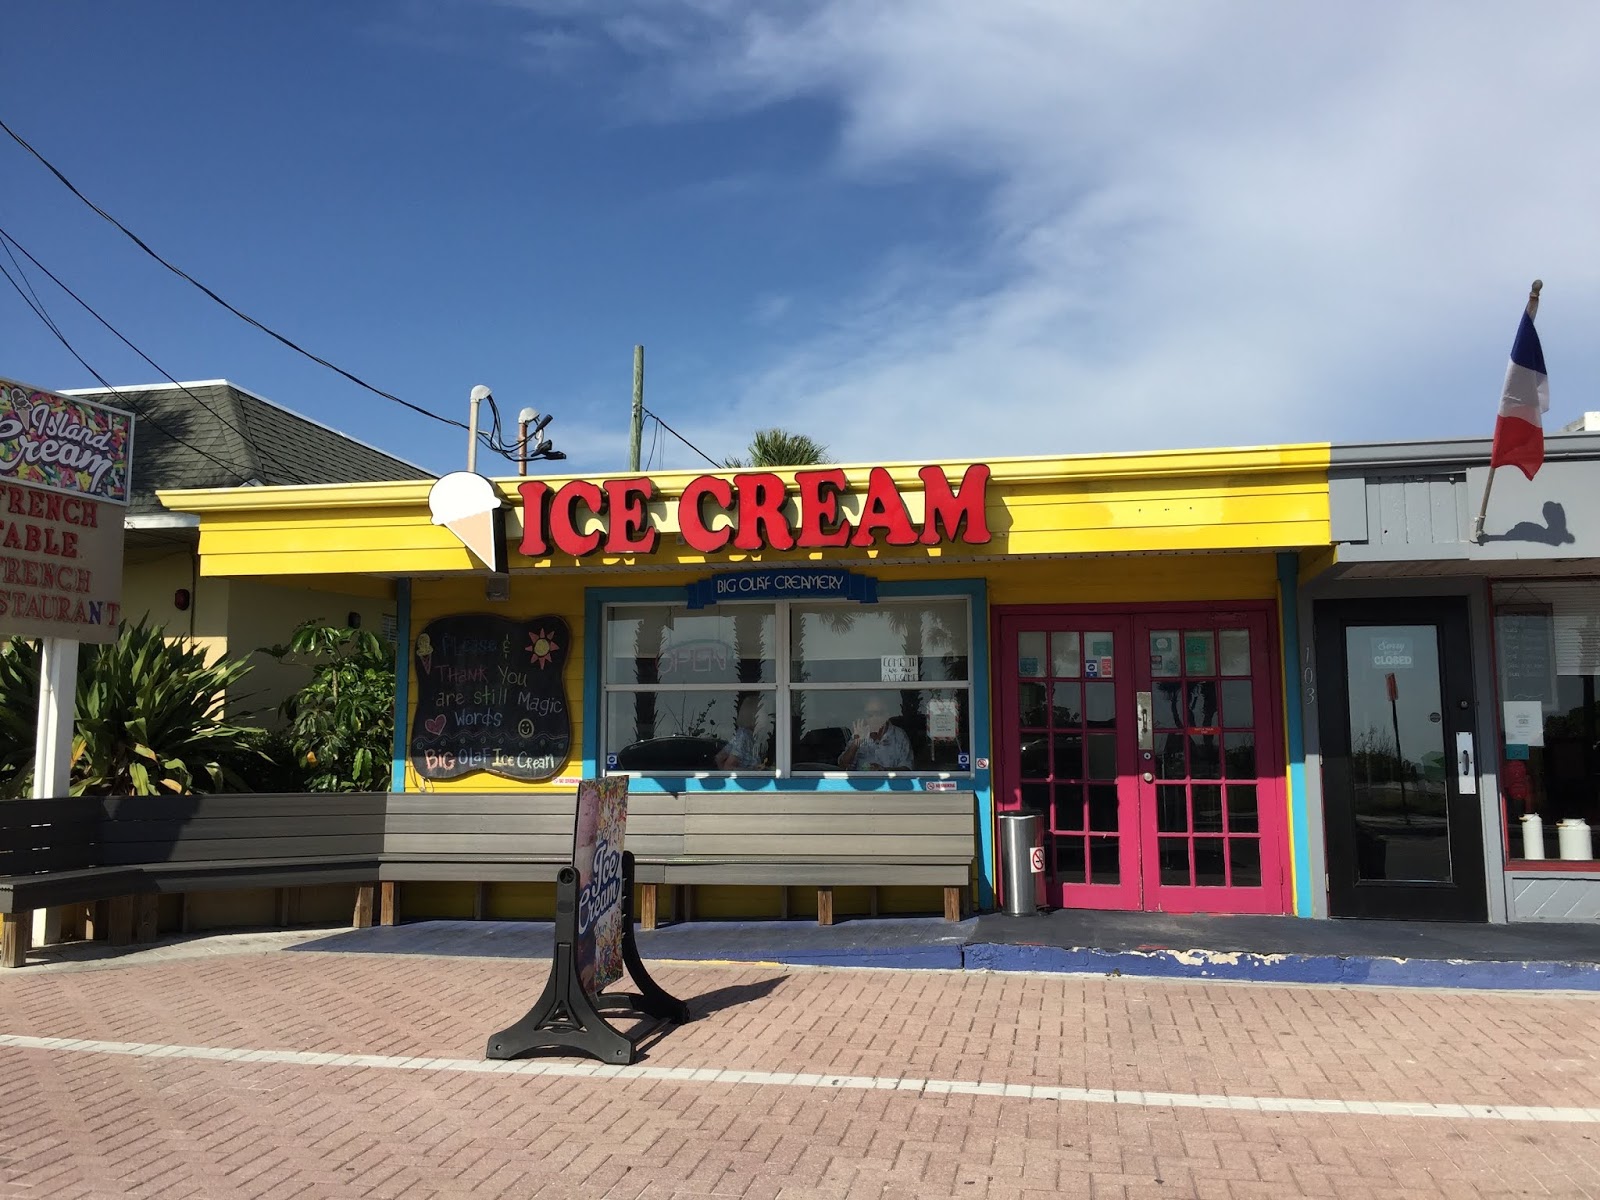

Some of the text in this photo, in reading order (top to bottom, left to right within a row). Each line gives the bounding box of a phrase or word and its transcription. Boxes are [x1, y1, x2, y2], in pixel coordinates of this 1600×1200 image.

[32, 404, 112, 450] Island
[517, 463, 991, 556] ICE CREAM
[0, 519, 79, 558] ABLE
[716, 578, 737, 594] BIG
[775, 574, 844, 590] CREAMERY
[655, 648, 727, 675] OPEN
[1374, 655, 1412, 665] CLOSED
[1376, 640, 1405, 653] Sorry
[1303, 646, 1315, 705] 103
[435, 685, 563, 717] are still Magic
[454, 708, 504, 728] Words
[492, 748, 515, 767] Ice
[591, 843, 618, 898] Ice
[578, 878, 619, 935] Cream
